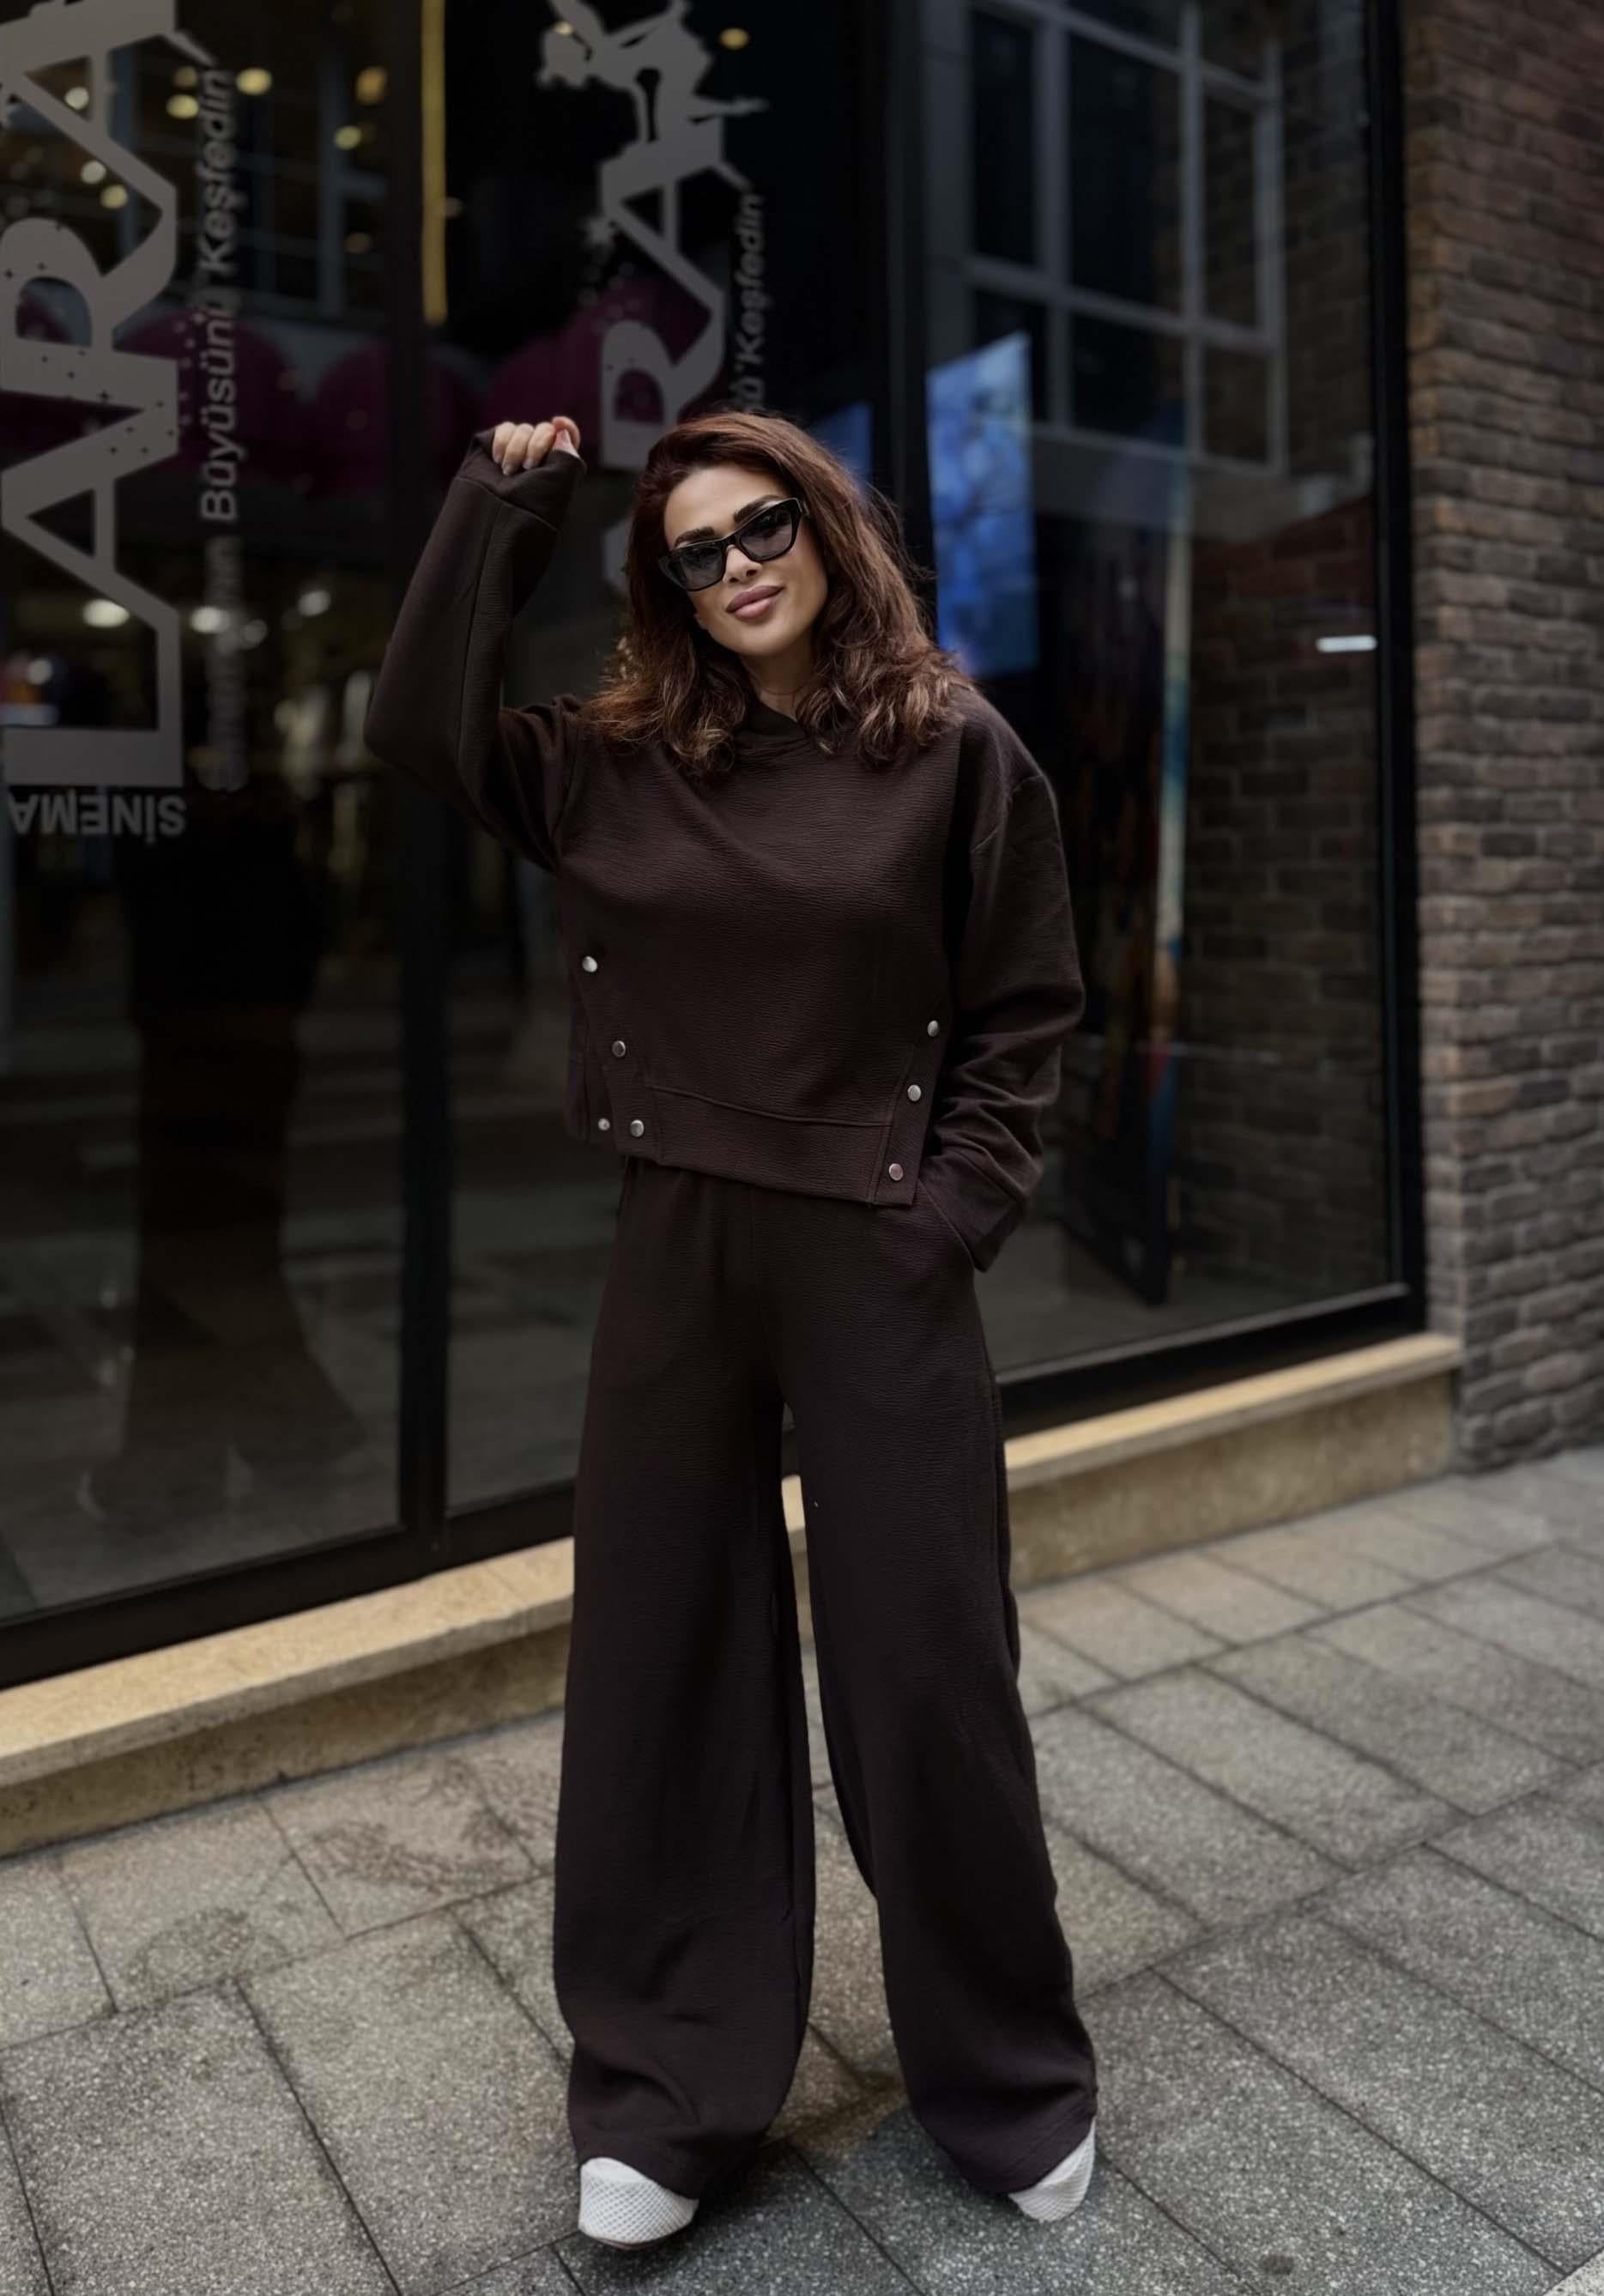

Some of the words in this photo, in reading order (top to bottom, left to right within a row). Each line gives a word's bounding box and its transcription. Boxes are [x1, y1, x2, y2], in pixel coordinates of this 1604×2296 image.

[194, 69, 246, 275] Keşfedin
[0, 0, 183, 788] LARA
[598, 142, 726, 594] RA
[7, 788, 188, 846] SİNEMA
